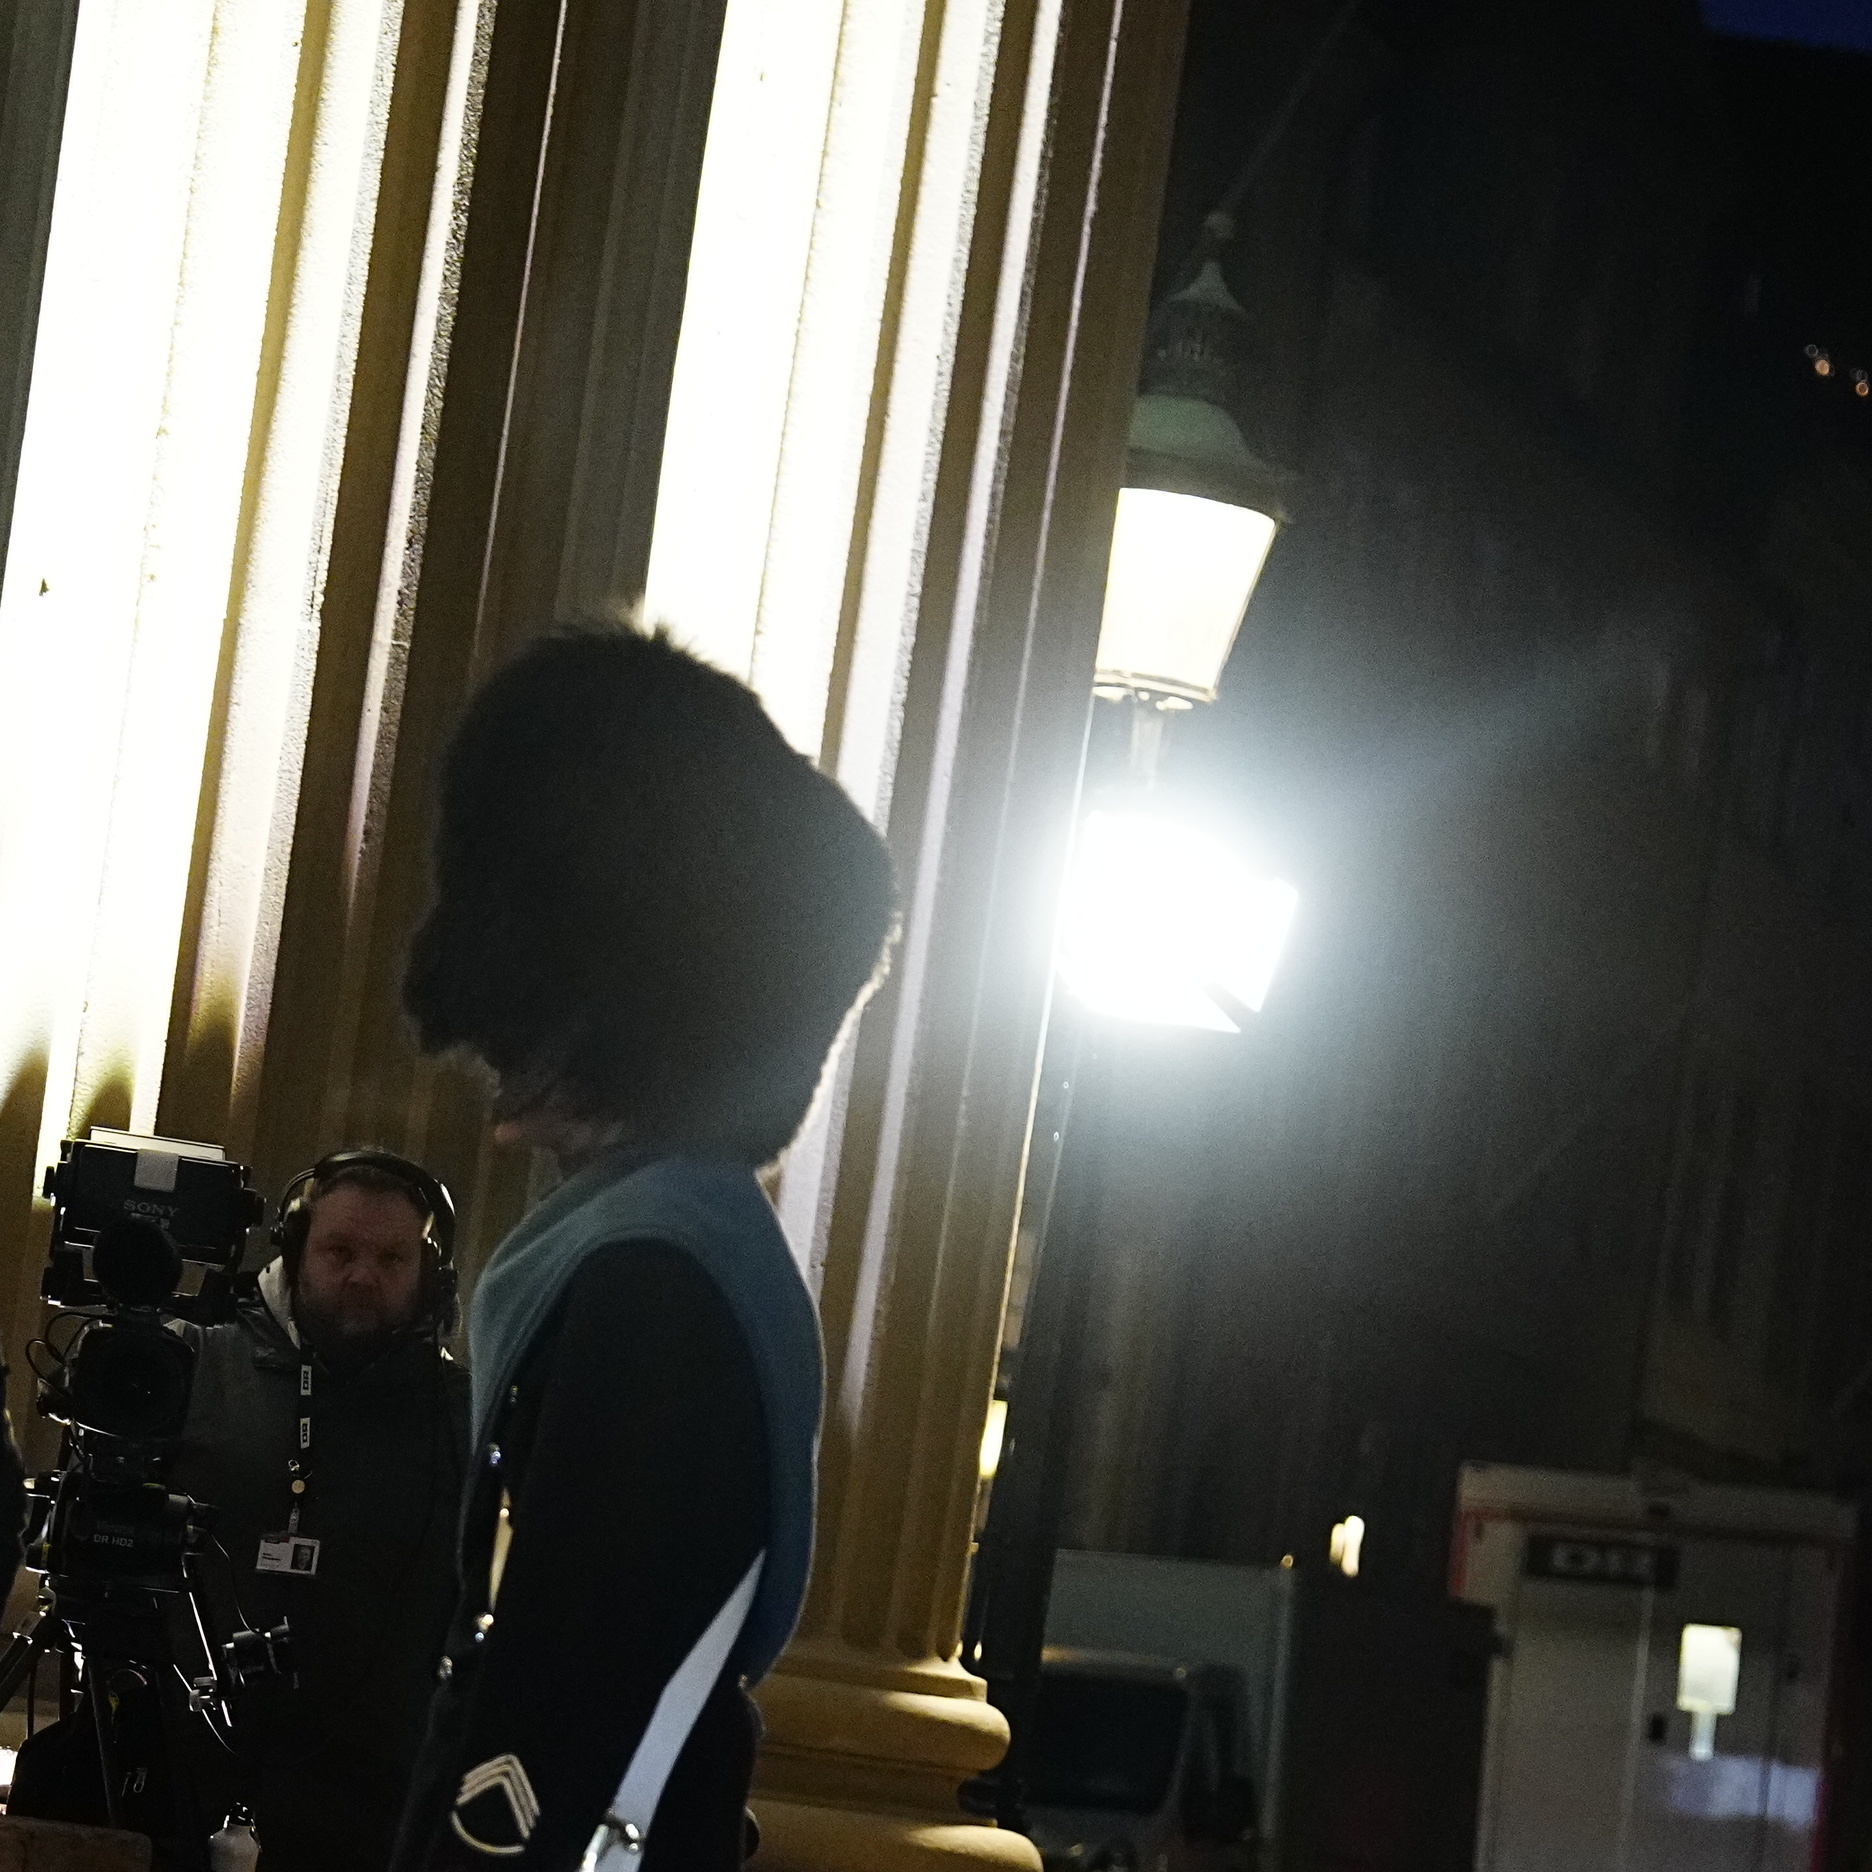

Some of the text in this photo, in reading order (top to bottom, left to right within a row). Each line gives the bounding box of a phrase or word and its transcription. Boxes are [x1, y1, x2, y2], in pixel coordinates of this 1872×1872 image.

[123, 1199, 180, 1217] SONY
[93, 1533, 134, 1548] DR HD2
